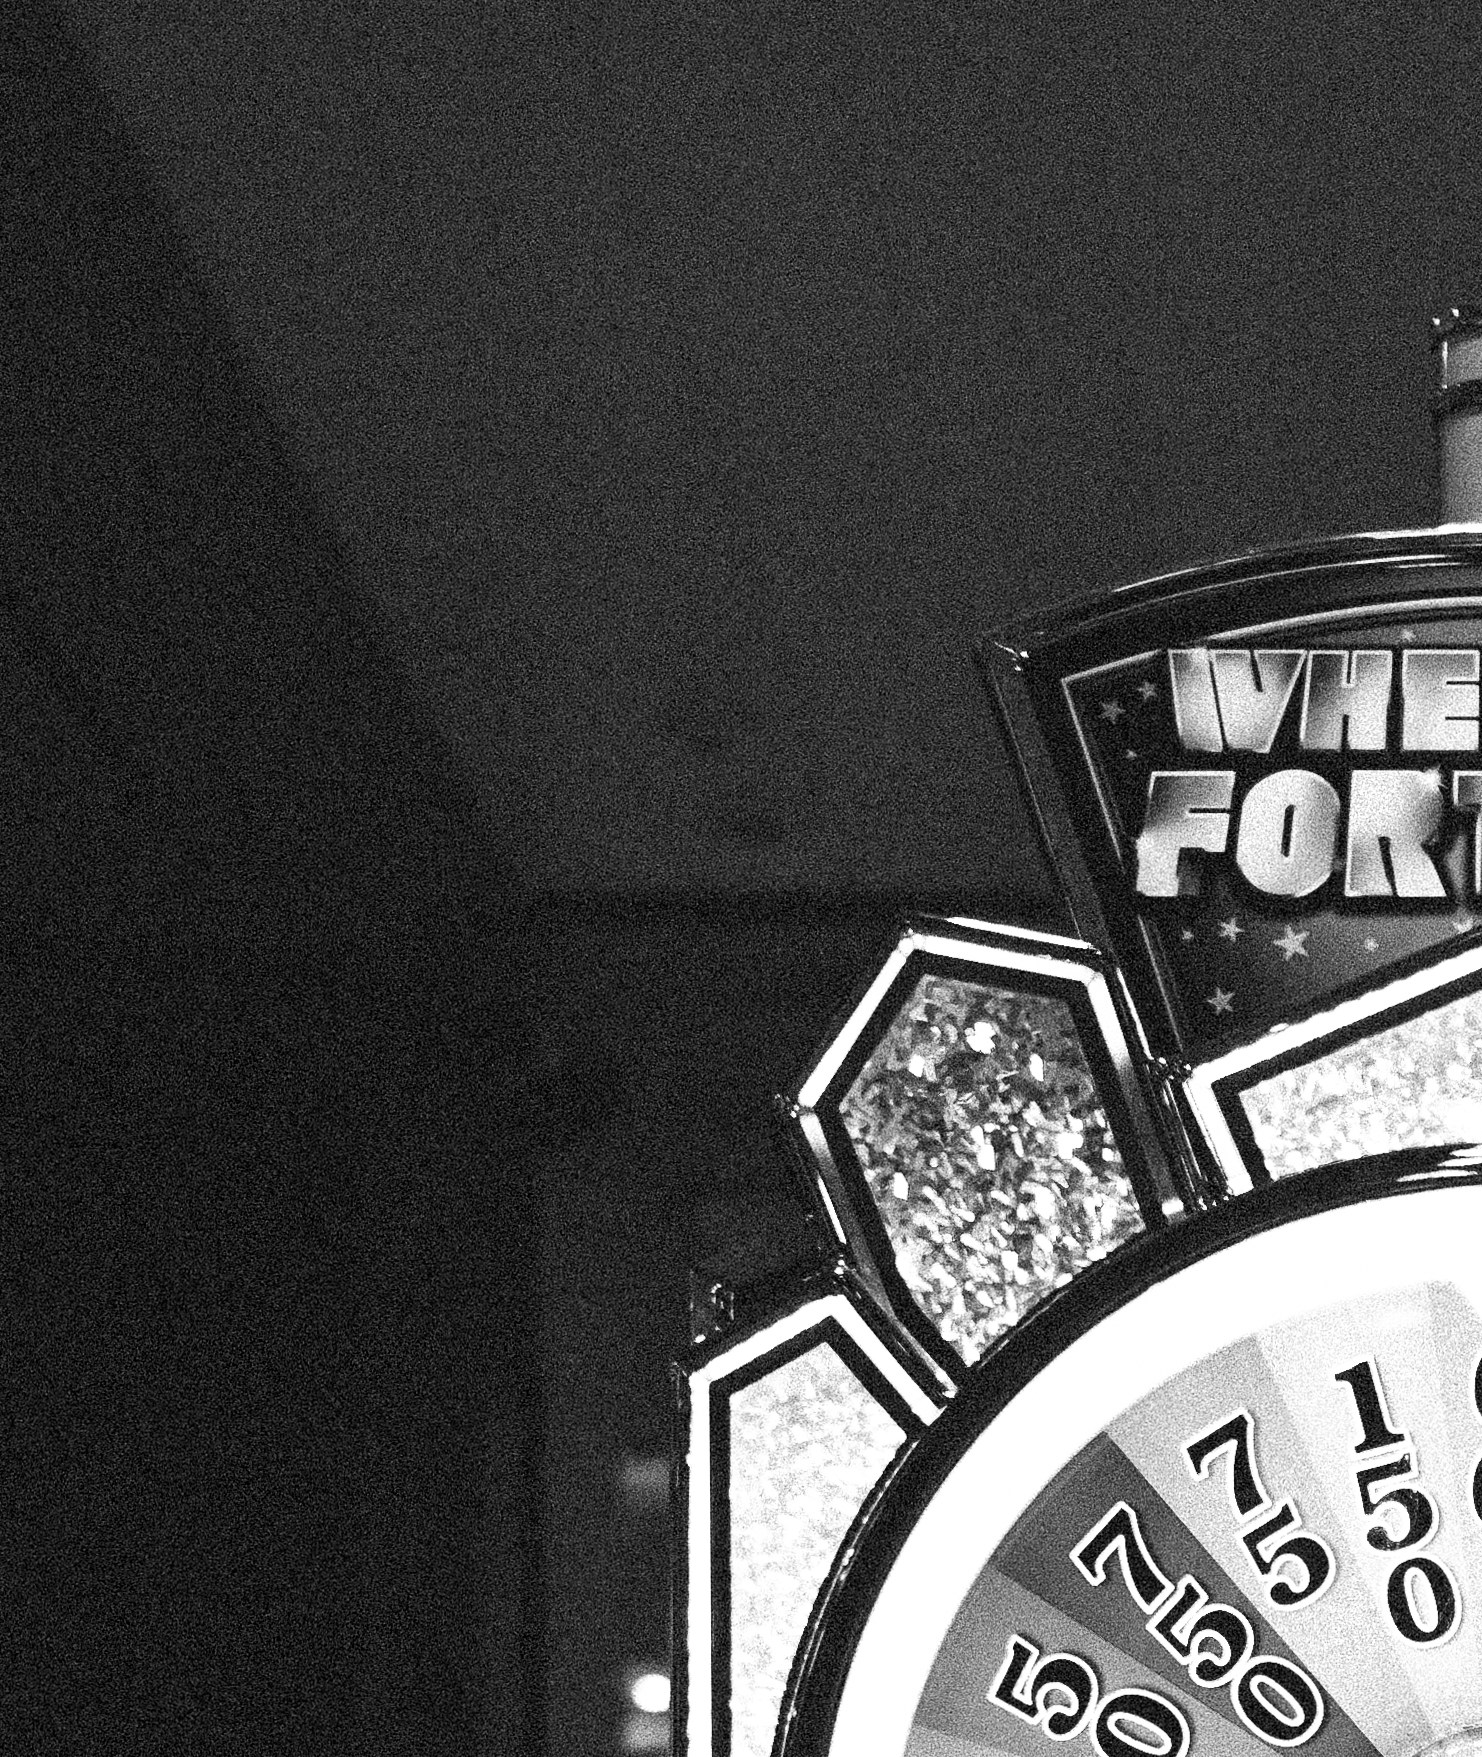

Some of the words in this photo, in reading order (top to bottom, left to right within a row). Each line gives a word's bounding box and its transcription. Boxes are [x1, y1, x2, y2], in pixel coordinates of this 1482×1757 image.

[1070, 1501, 1324, 1747] 750
[1181, 1410, 1337, 1611] 75
[1334, 1359, 1463, 1649] 150
